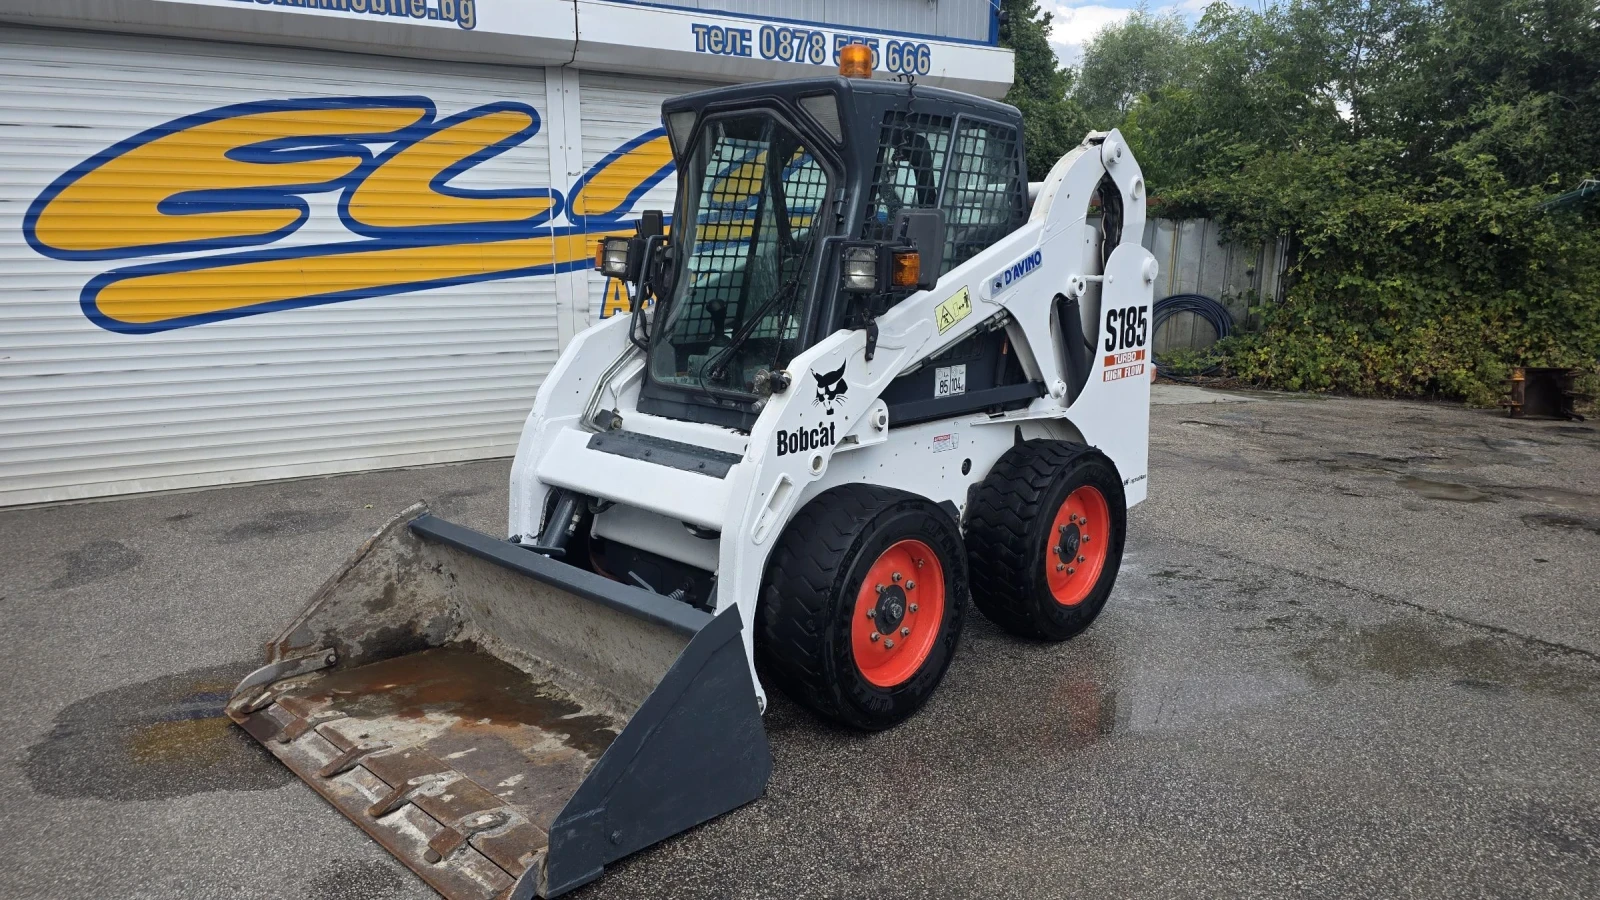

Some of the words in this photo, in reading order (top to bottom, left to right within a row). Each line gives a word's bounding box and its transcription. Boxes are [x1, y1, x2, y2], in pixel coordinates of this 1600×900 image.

[692, 23, 752, 57] тел:
[759, 25, 826, 65] 0878
[886, 40, 931, 75] 666
[1004, 251, 1042, 285] D'AVINO
[1105, 305, 1148, 352] S185
[1105, 368, 1122, 381] HIGH
[1125, 364, 1143, 378] FLOW
[1114, 352, 1137, 365] TURBO
[776, 421, 835, 456] Bobcat
